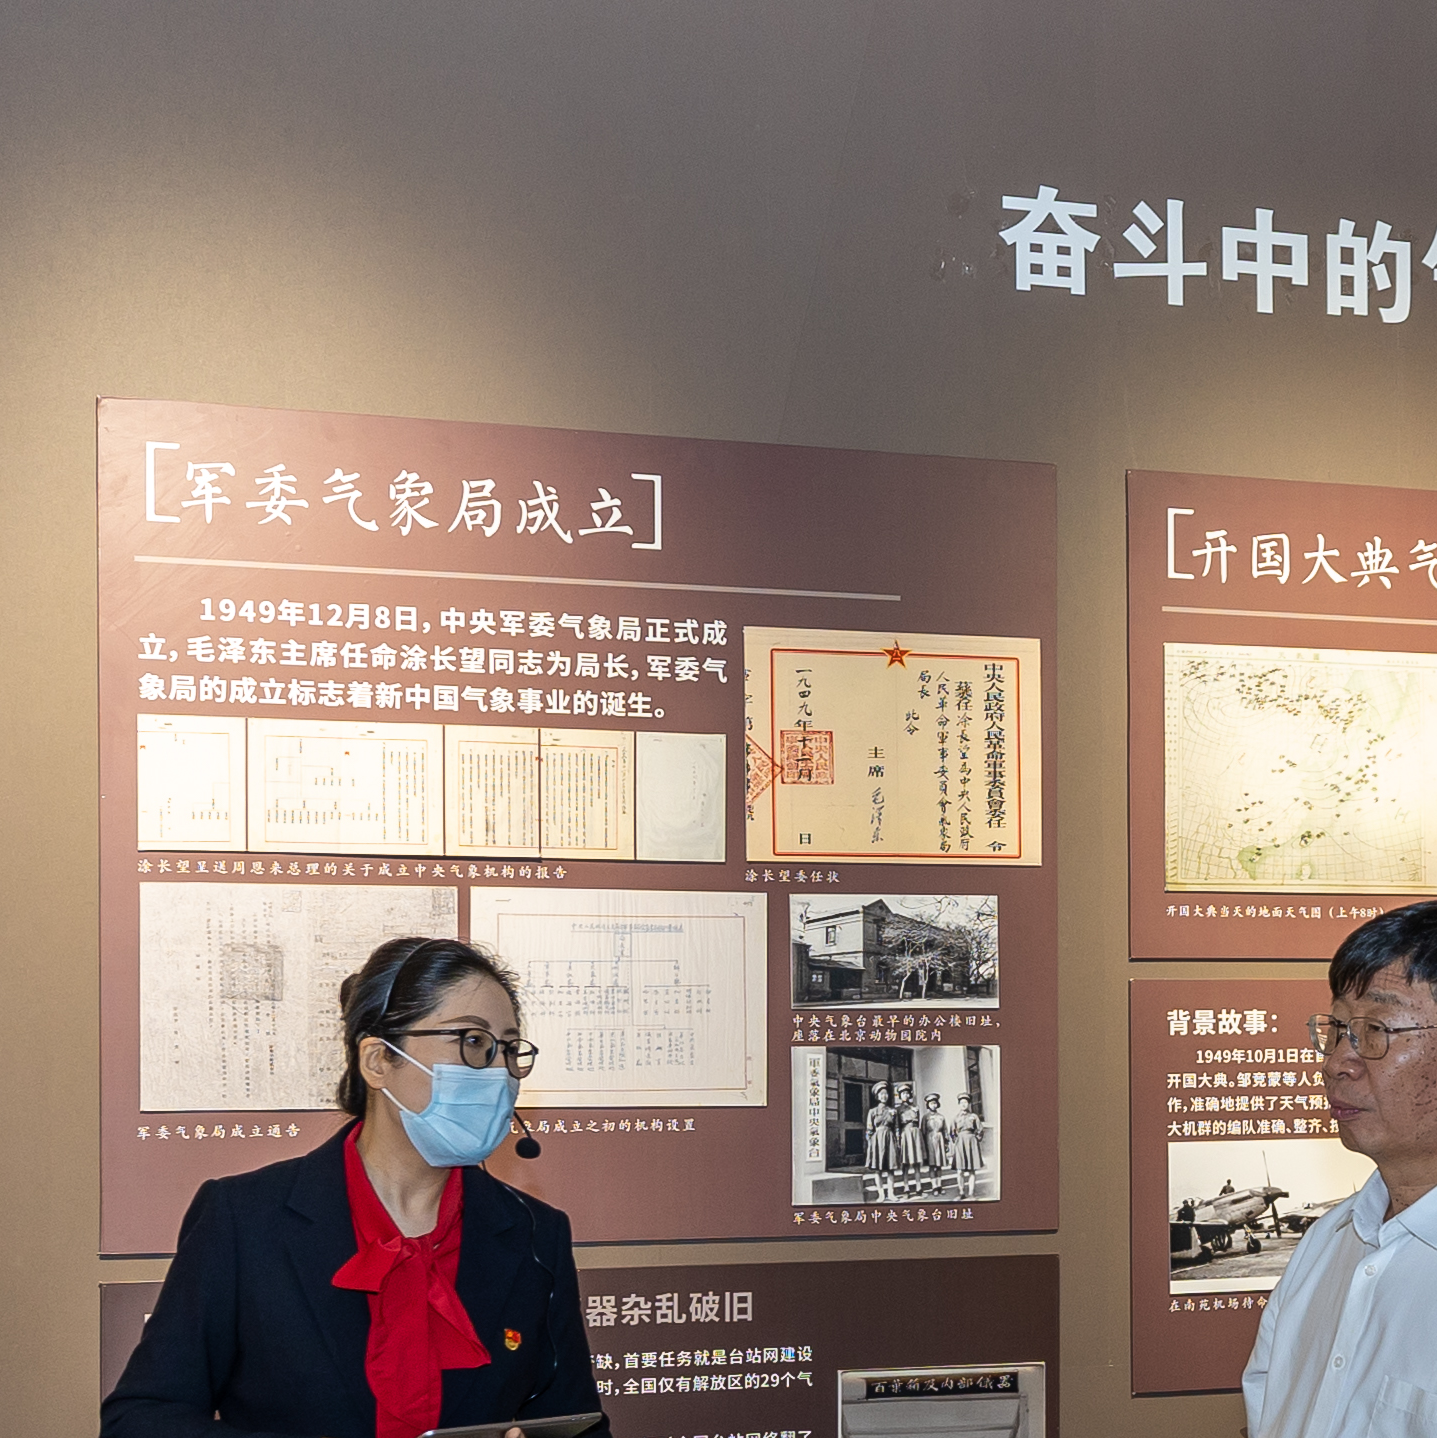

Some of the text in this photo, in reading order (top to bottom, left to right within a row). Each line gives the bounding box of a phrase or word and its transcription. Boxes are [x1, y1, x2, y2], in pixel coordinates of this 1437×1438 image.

[744, 869, 841, 884] 涂长望委任状
[1166, 1008, 1278, 1036] 背景故事：
[136, 1122, 302, 1140] 军委气象局成立通告
[792, 1207, 975, 1226] 军委气象局中央气象台旧址
[585, 1291, 754, 1328] 器杂乱破旧
[590, 1345, 813, 1370] 缺，首要任务就是台站网建设
